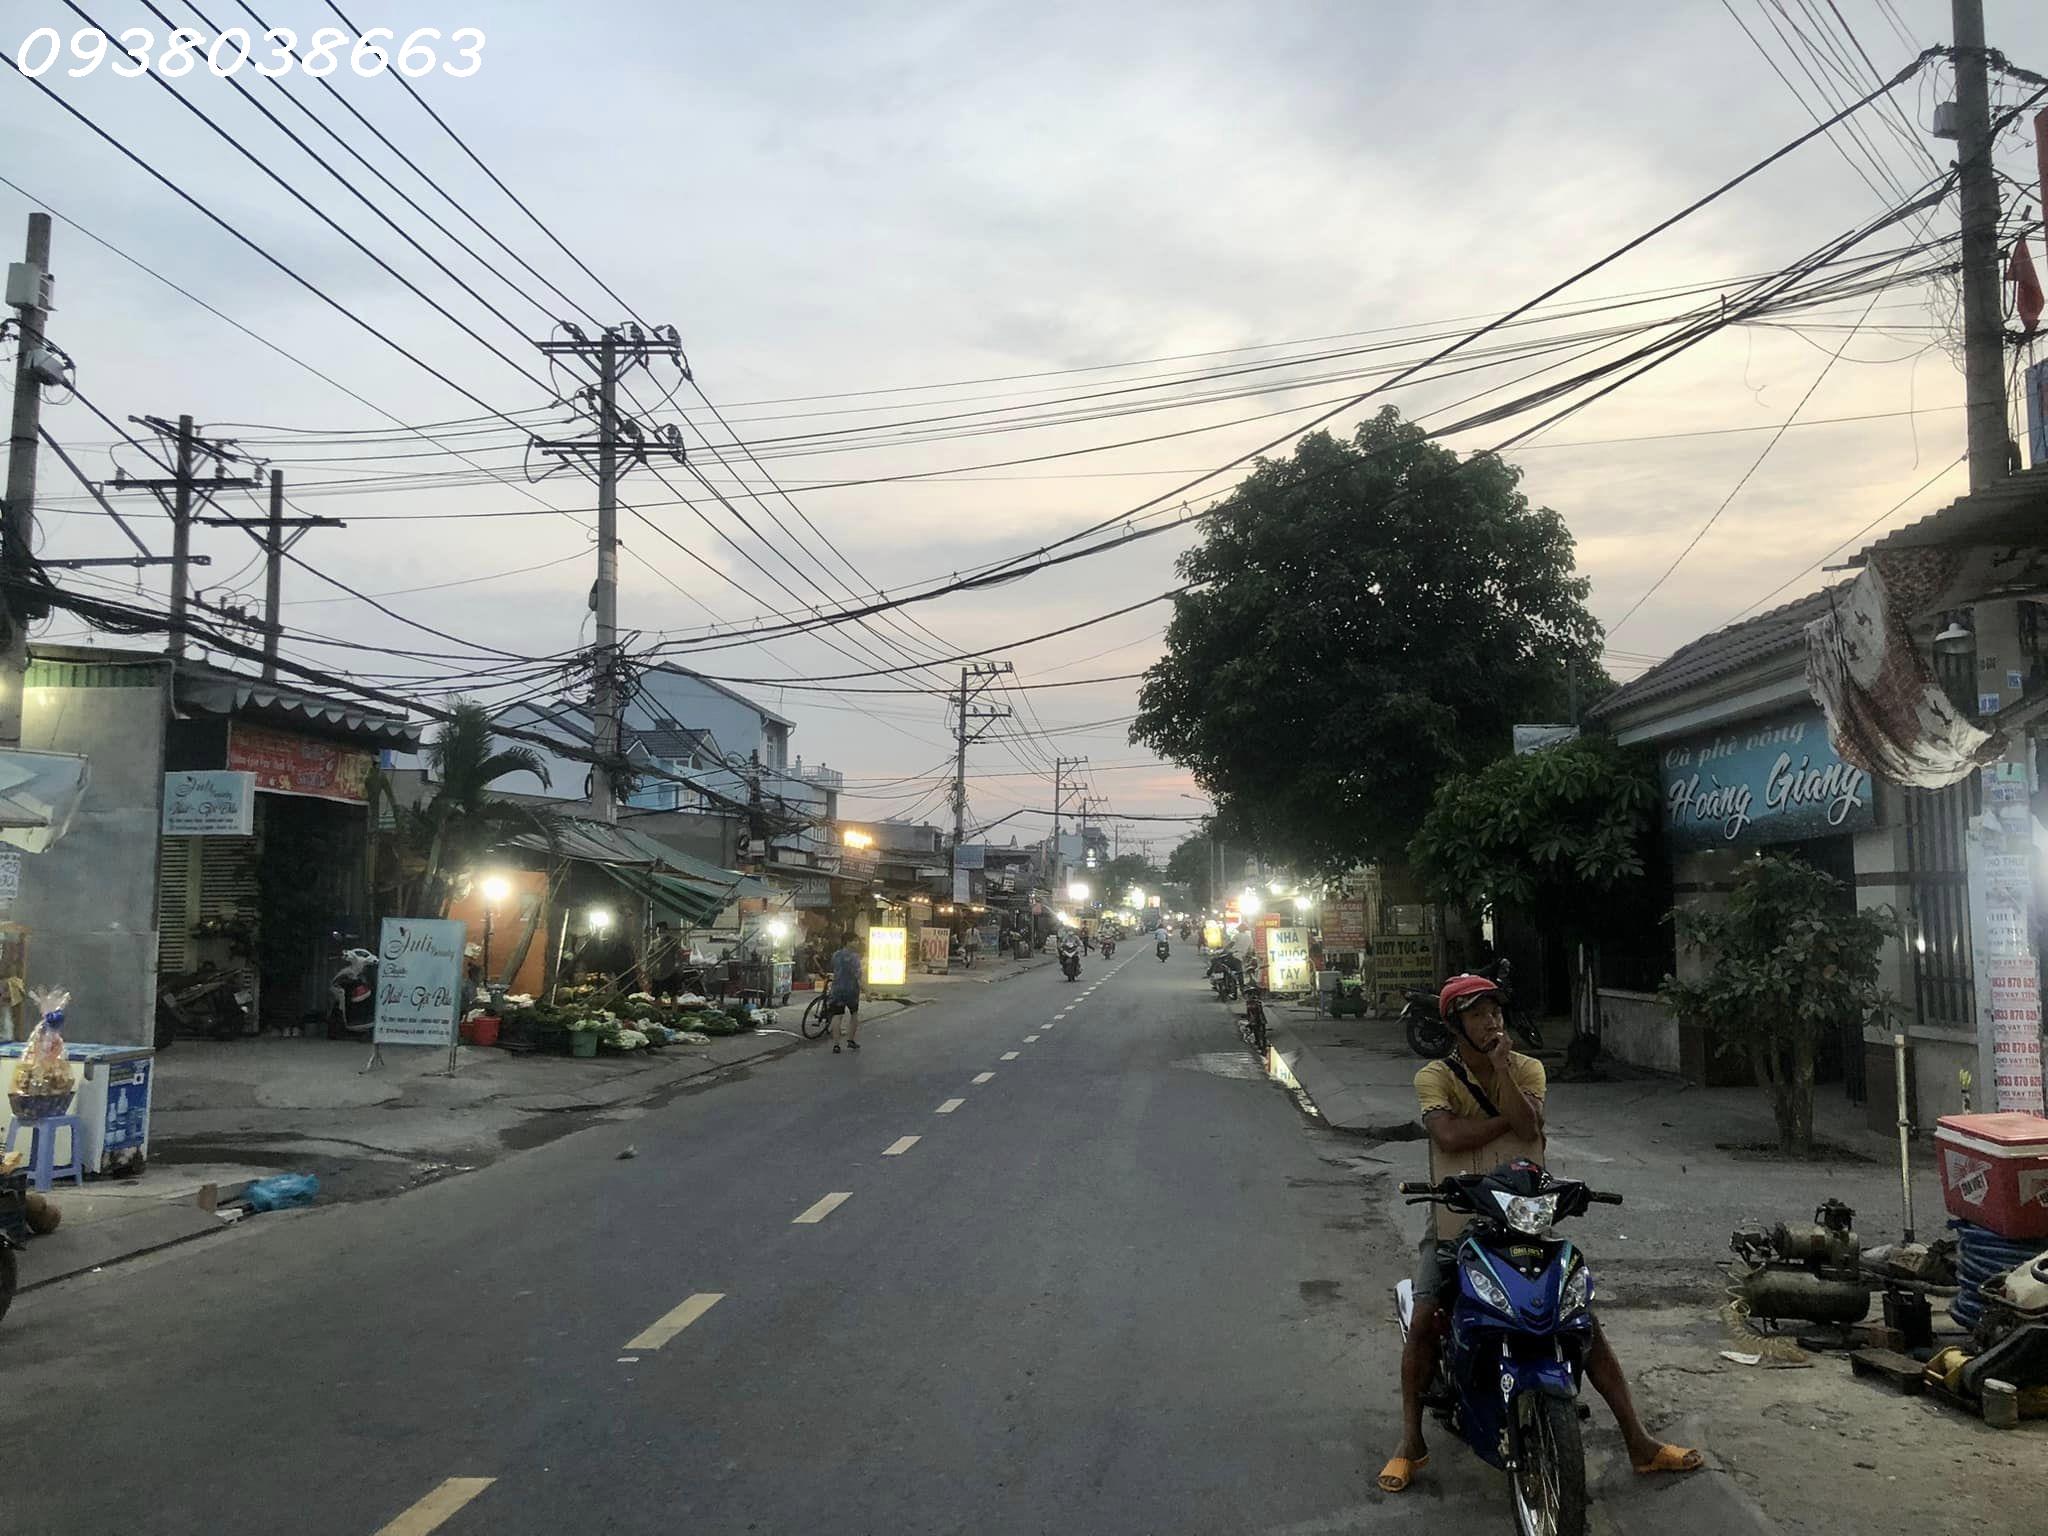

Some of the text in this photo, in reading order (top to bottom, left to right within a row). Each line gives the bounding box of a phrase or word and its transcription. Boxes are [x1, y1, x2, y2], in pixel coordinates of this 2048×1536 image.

[1699, 736, 1738, 768] phê
[1669, 751, 1863, 840] Hoàng Giang
